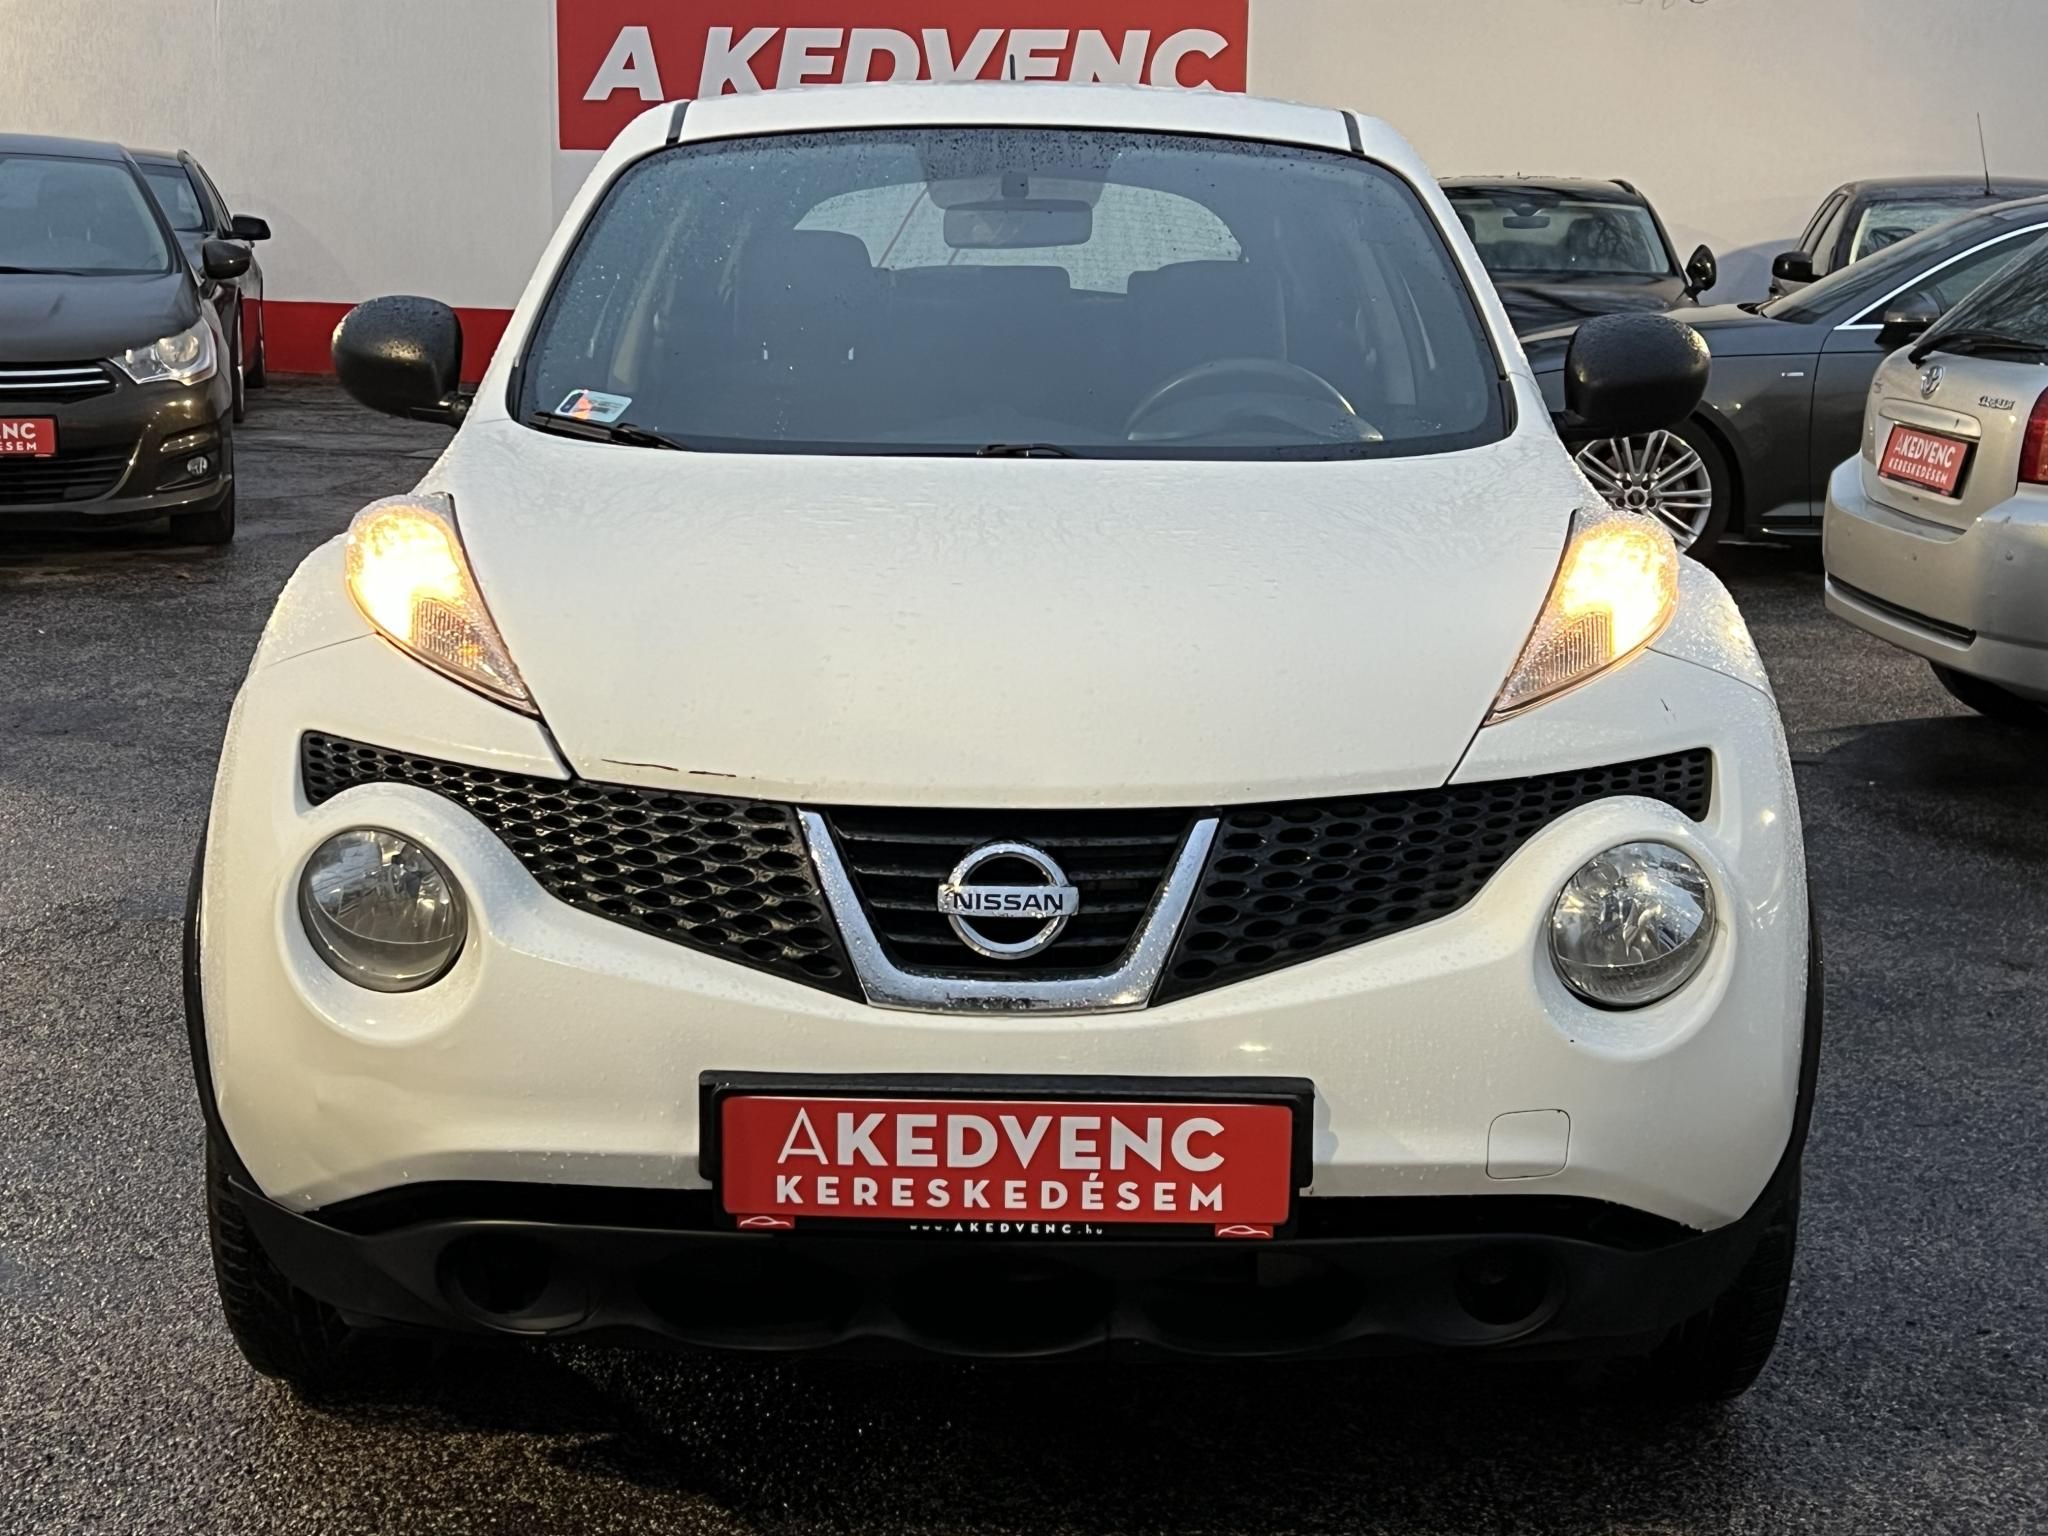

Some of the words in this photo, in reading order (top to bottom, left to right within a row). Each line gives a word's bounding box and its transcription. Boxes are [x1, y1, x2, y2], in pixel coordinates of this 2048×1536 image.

[583, 25, 665, 101] A
[697, 26, 1229, 100] KEDVENC
[1894, 434, 1956, 469] AKEDVENC
[953, 893, 1063, 912] NISSAN
[776, 1107, 1226, 1172] AKEDVENC
[776, 1172, 1224, 1212] KERESKEDÉSEM
[909, 1222, 1104, 1236] www.AKEDVENC.hu
